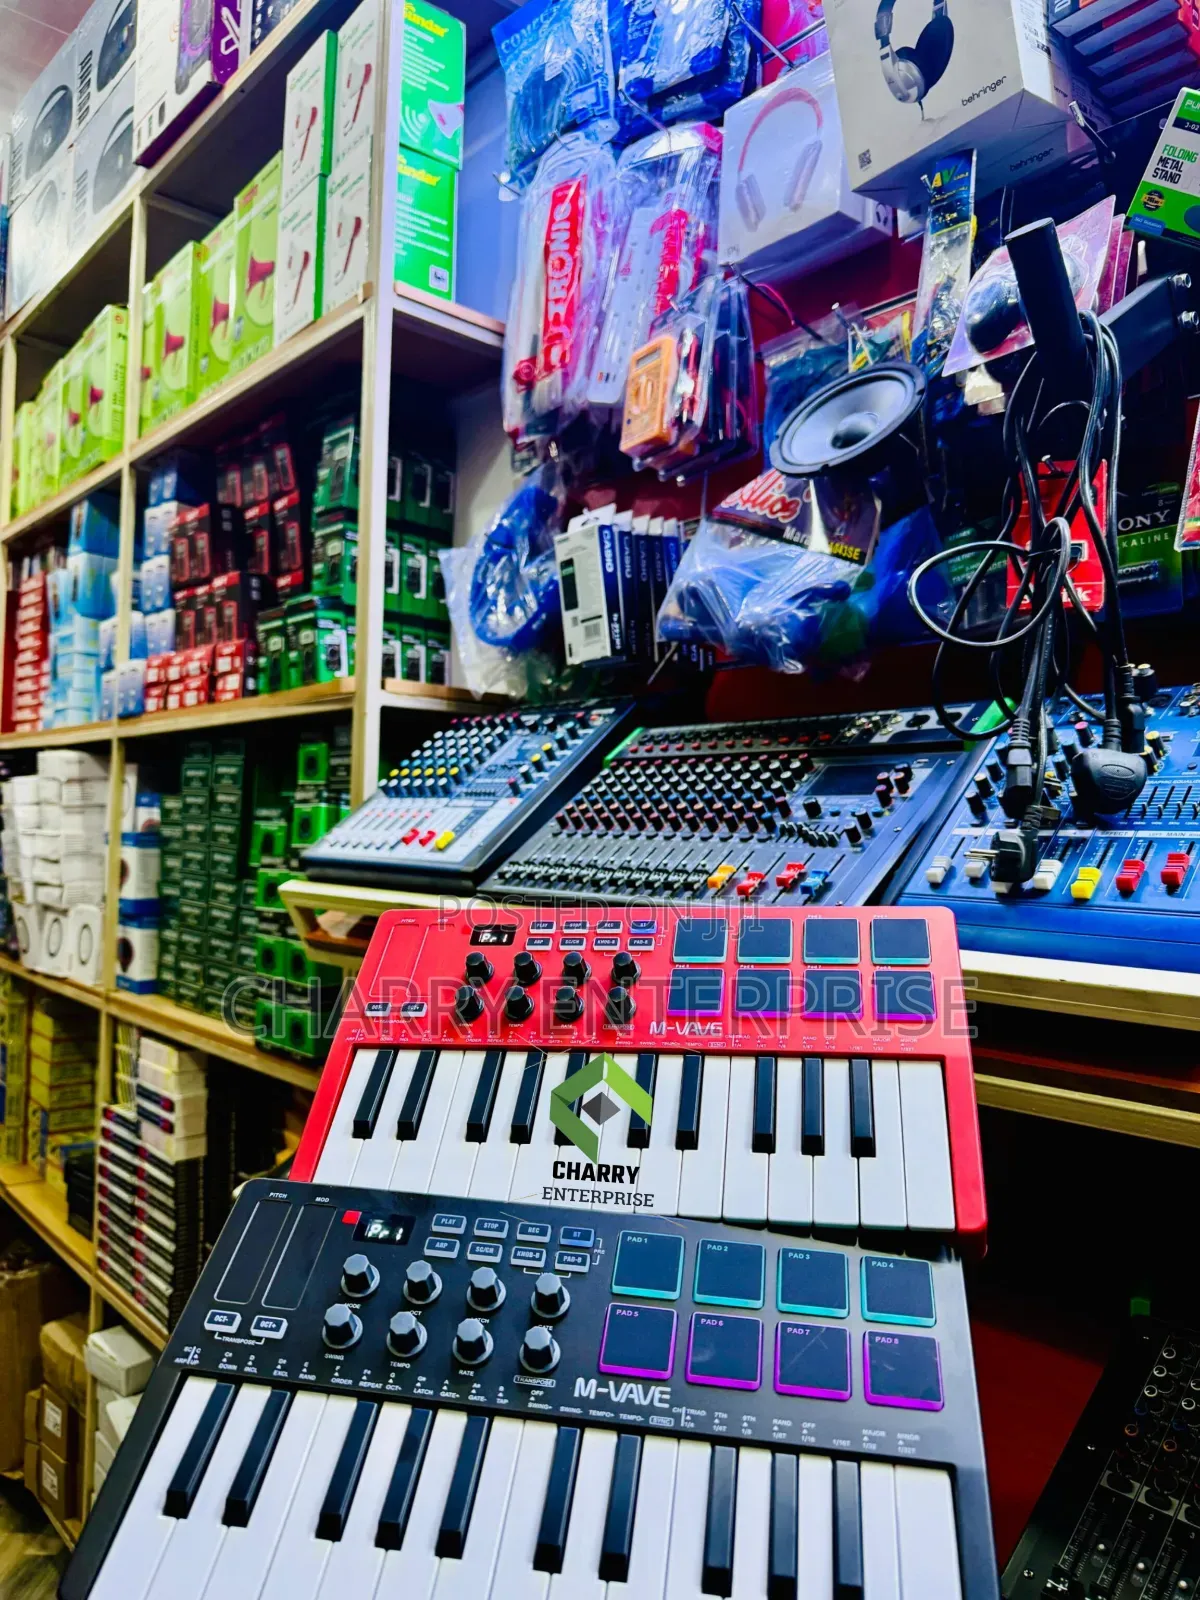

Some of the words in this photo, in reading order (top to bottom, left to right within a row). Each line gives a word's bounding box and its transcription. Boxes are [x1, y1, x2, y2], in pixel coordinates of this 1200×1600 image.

[962, 75, 1007, 107] behringer
[1162, 144, 1198, 164] FOLDING
[1156, 156, 1183, 173] METAL
[1152, 167, 1182, 185] STAND
[1117, 509, 1170, 532] ONY
[1121, 532, 1169, 548] KALINE
[602, 529, 615, 573] CASIO
[623, 535, 633, 579] CASIO
[650, 1020, 722, 1037] M-VAVE
[269, 1191, 287, 1199] PITCH
[214, 1314, 229, 1322] OCT-
[701, 1318, 717, 1326] PAD
[260, 1320, 277, 1328] OCT+
[787, 1327, 803, 1335] PAD
[222, 1336, 257, 1345] TRANSPOSE
[875, 1336, 892, 1344] PAD
[390, 1361, 411, 1369] TEMPO
[359, 1381, 383, 1389] REPEAT
[574, 1377, 671, 1408] M-VAVE
[527, 1402, 553, 1410] SWING+
[559, 1406, 583, 1414] SWING-
[589, 1409, 615, 1418] TEMPO+
[687, 1408, 707, 1416] TRIAD
[619, 1413, 644, 1422] TEMPO-
[653, 1417, 671, 1425] SYNC
[773, 1419, 792, 1427] RAND
[862, 1428, 886, 1437] MAJOR
[897, 1432, 920, 1441] MINOR
